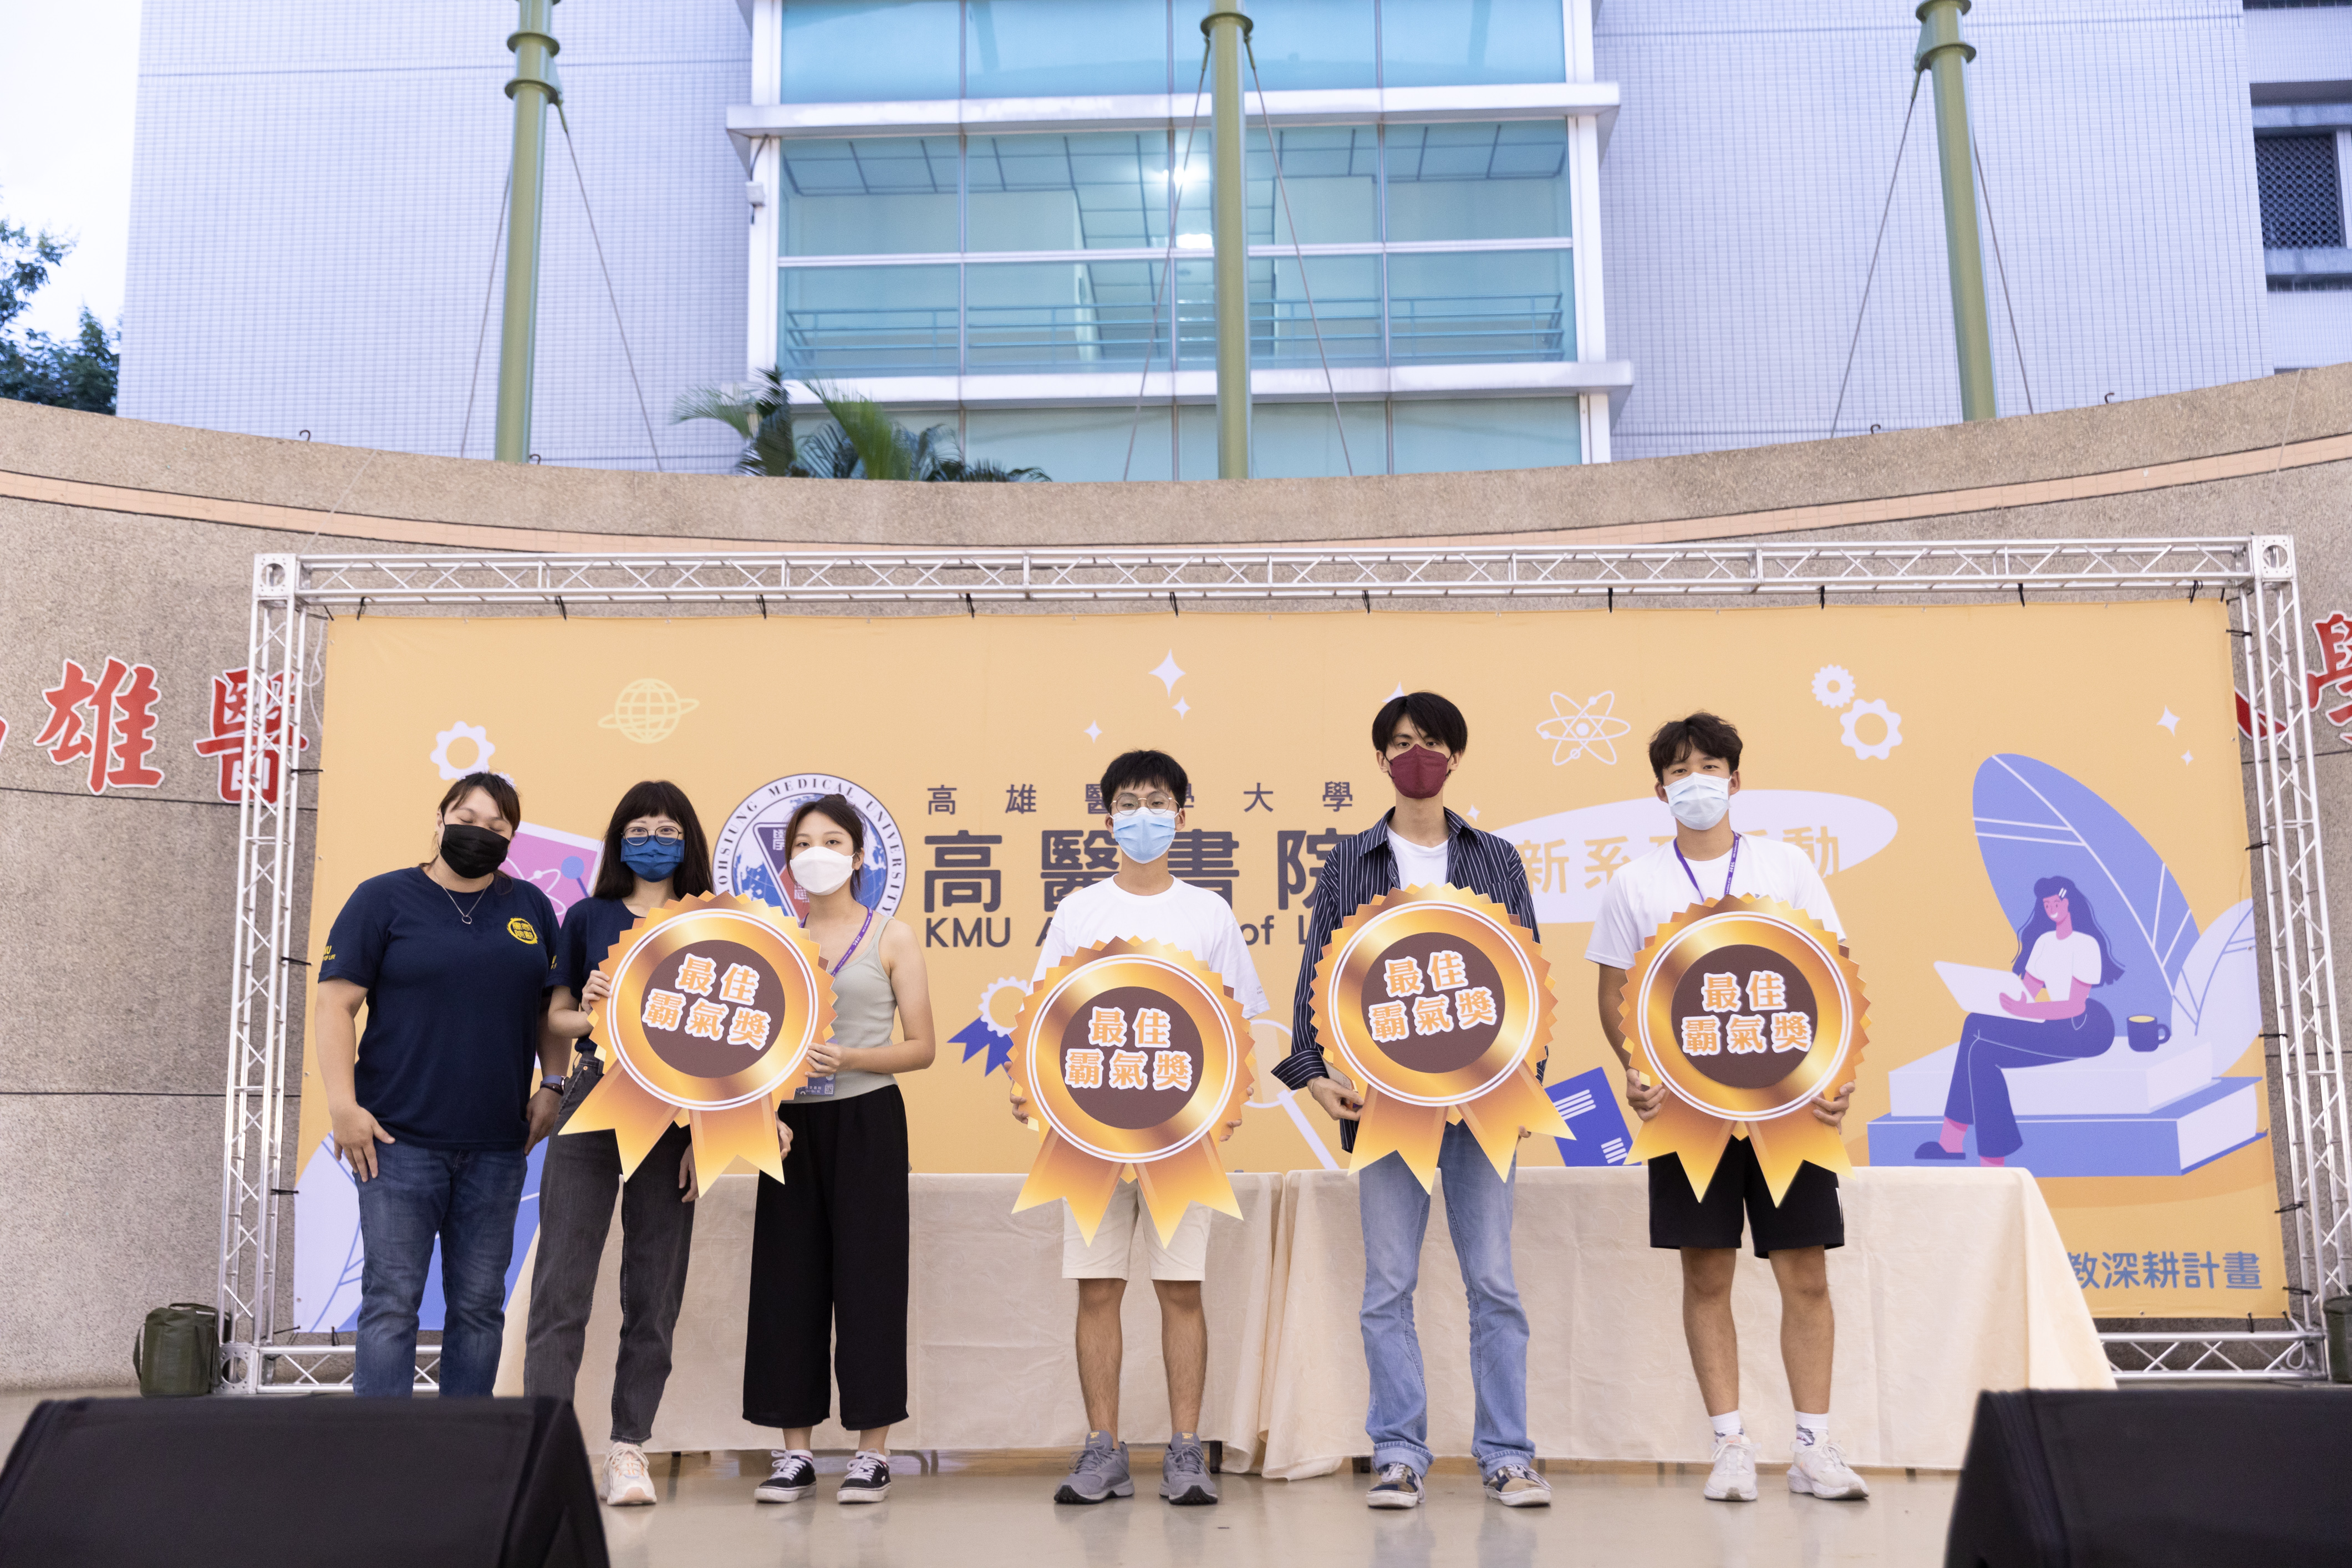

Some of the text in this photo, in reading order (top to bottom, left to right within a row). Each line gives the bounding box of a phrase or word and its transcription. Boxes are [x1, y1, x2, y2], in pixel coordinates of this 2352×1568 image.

[927, 781, 1353, 816] 高雄醫大學
[717, 778, 902, 915] OHSIUNG MEDICAL UNIVERSITY
[1515, 825, 1840, 895] 新系動
[926, 917, 1010, 947] KMU
[1241, 915, 1274, 945] of
[675, 954, 760, 1006] 最佳
[1383, 950, 1468, 997] 最佳
[1701, 970, 1786, 1012] 最佳
[1088, 1006, 1171, 1047] 最佳
